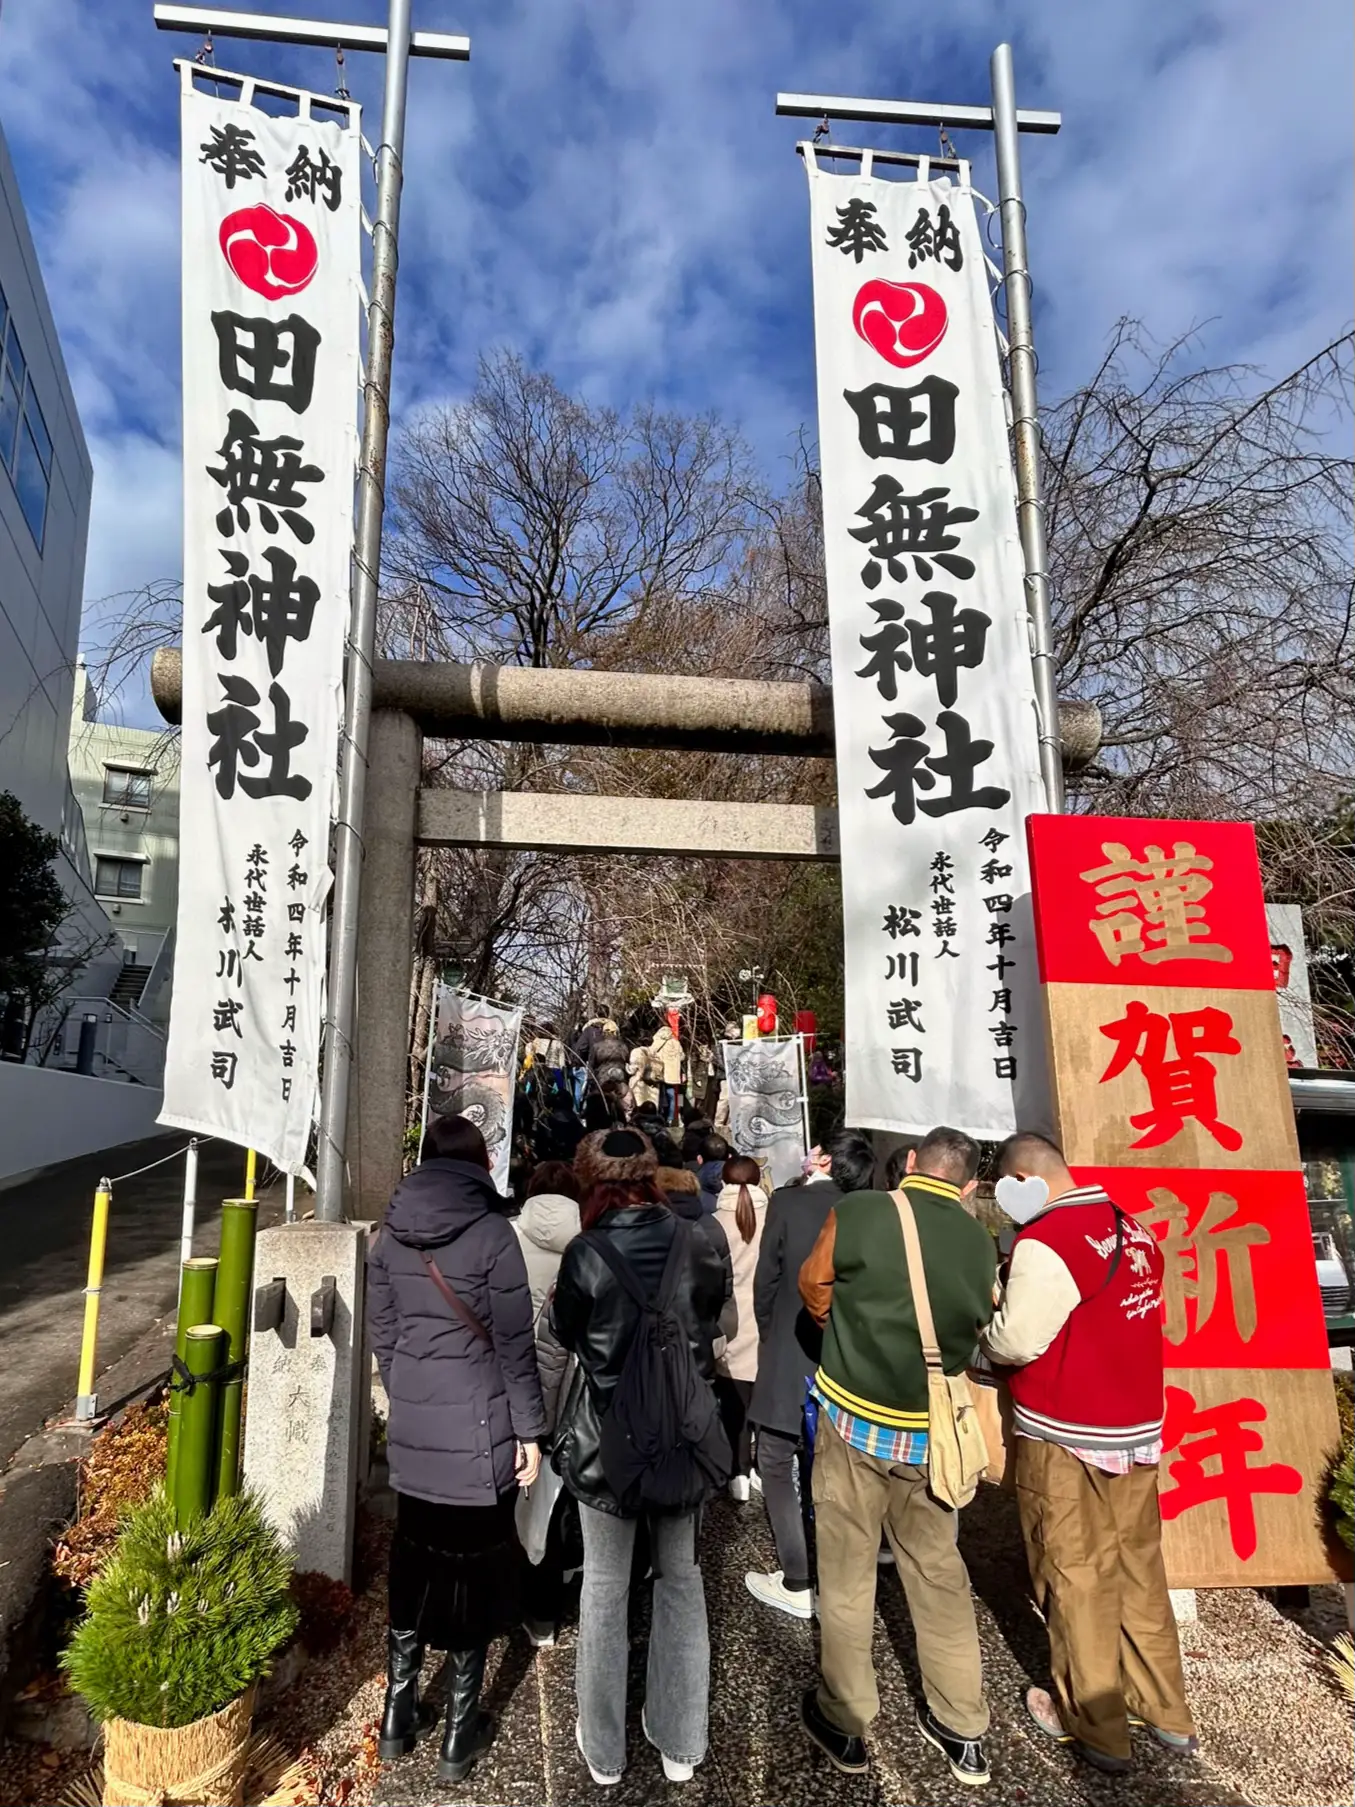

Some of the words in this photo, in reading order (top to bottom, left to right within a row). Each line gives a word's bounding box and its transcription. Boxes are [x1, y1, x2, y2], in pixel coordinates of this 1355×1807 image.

[198, 123, 343, 212] 奉納
[825, 197, 964, 272] 奉納
[201, 309, 326, 802] 田無神社
[843, 374, 1011, 826] 田無神社
[242, 843, 270, 962] 永代世話人
[279, 828, 309, 1104] 令和四年十月吉日
[881, 904, 926, 1084] 松川武司
[929, 850, 961, 959] 永代世話人
[978, 827, 1018, 1081] 令和四年十月吉日
[1079, 841, 1304, 1563] 謹賀新年
